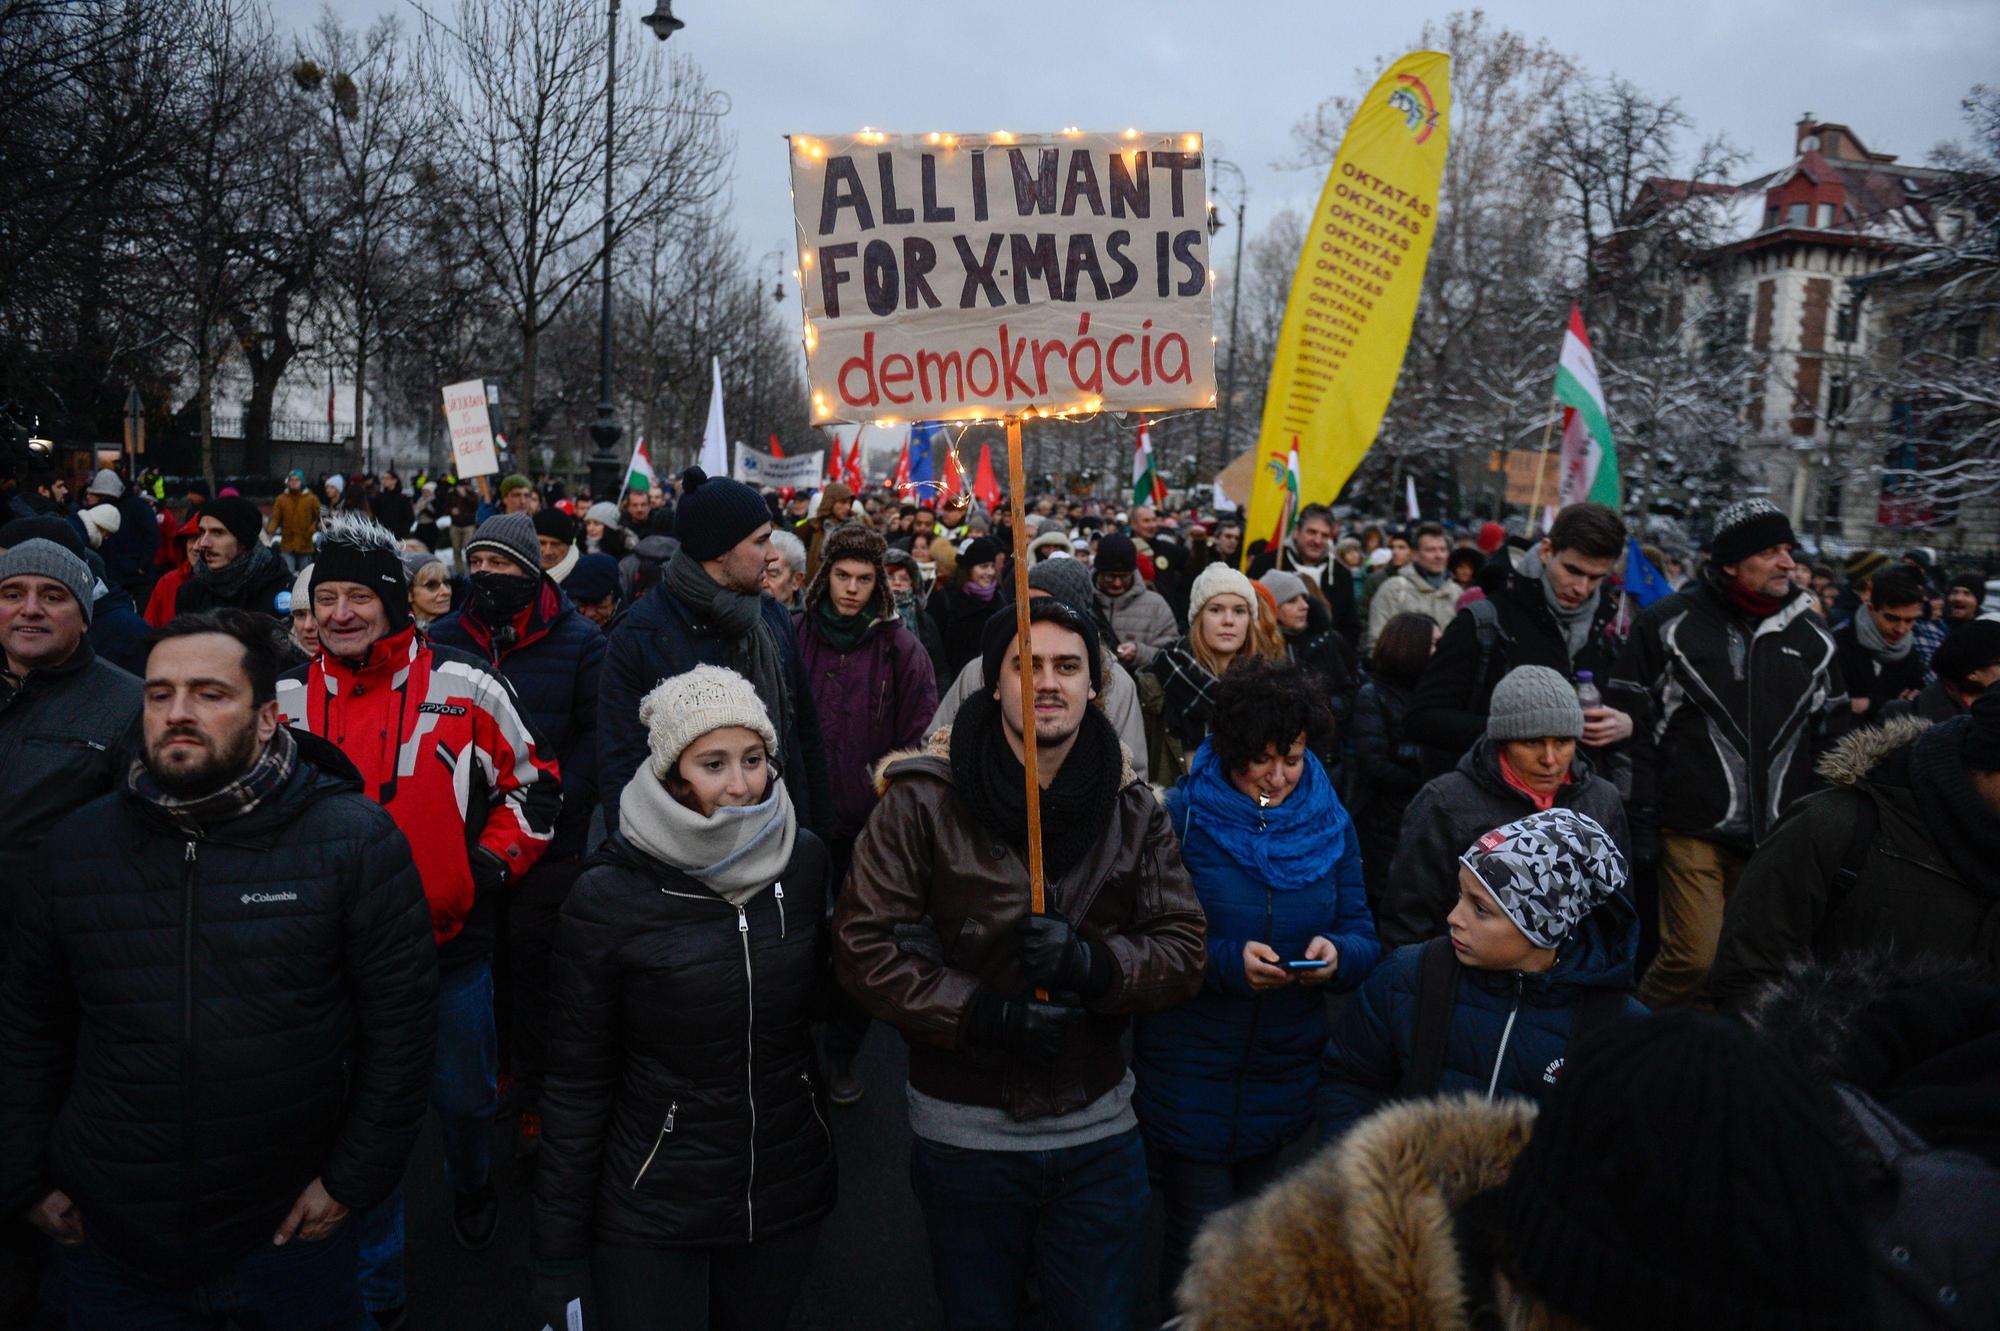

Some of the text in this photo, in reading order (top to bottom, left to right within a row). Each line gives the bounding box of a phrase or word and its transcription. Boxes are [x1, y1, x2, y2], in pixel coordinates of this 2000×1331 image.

[819, 148, 1202, 235] ALL I WANT
[1334, 183, 1421, 235] OKTATÁS
[1341, 162, 1432, 218] OKTATÁS
[1324, 223, 1402, 267] OKTATÁS
[1329, 204, 1411, 251] OKTATÁS
[819, 230, 1206, 319] FOR X-MAS IS
[1315, 259, 1384, 297] OKTATÁS
[1320, 241, 1393, 282] OKTATÁS
[1312, 276, 1374, 311] OKTATÁS
[837, 312, 1193, 408] demokrácia
[419, 703, 466, 715] SPYDER
[251, 891, 298, 903] Columbia
